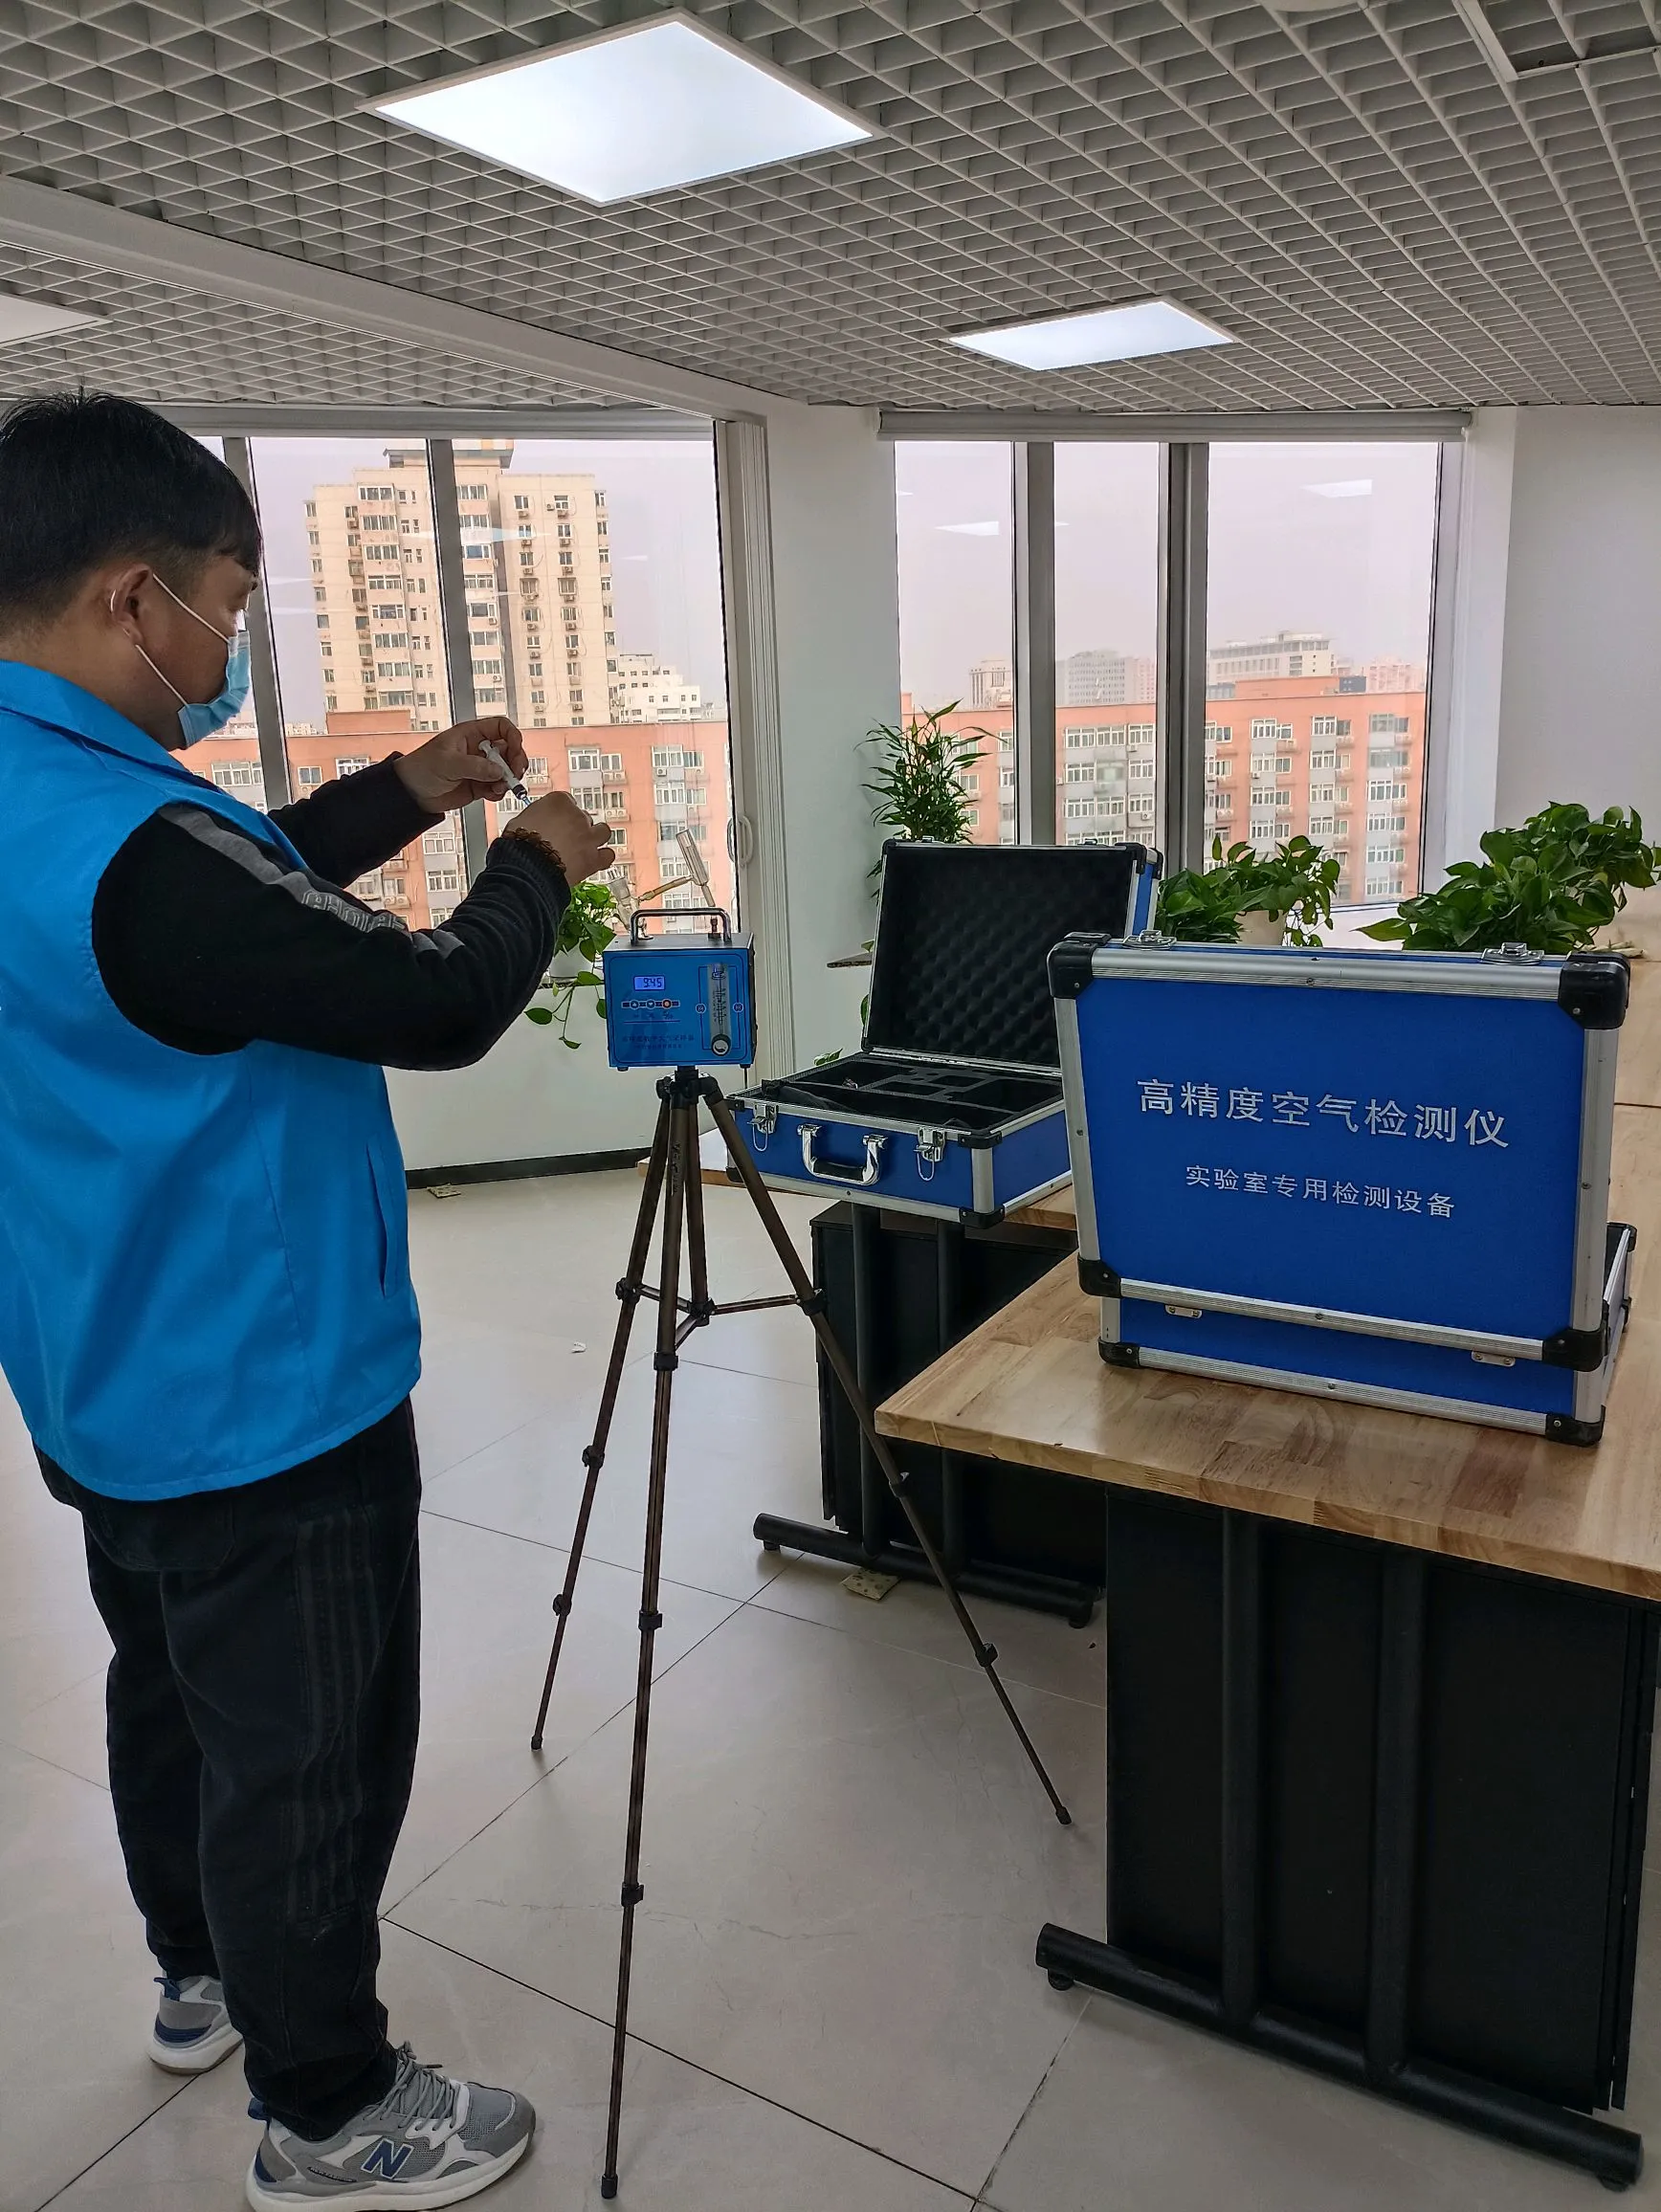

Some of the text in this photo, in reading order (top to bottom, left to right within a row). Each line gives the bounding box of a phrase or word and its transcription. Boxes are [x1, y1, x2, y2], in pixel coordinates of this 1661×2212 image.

[1137, 1078, 1509, 1148] 高精度空气检测仪
[1185, 1164, 1455, 1219] 实验室专用检测设备
[361, 2137, 414, 2179] N
